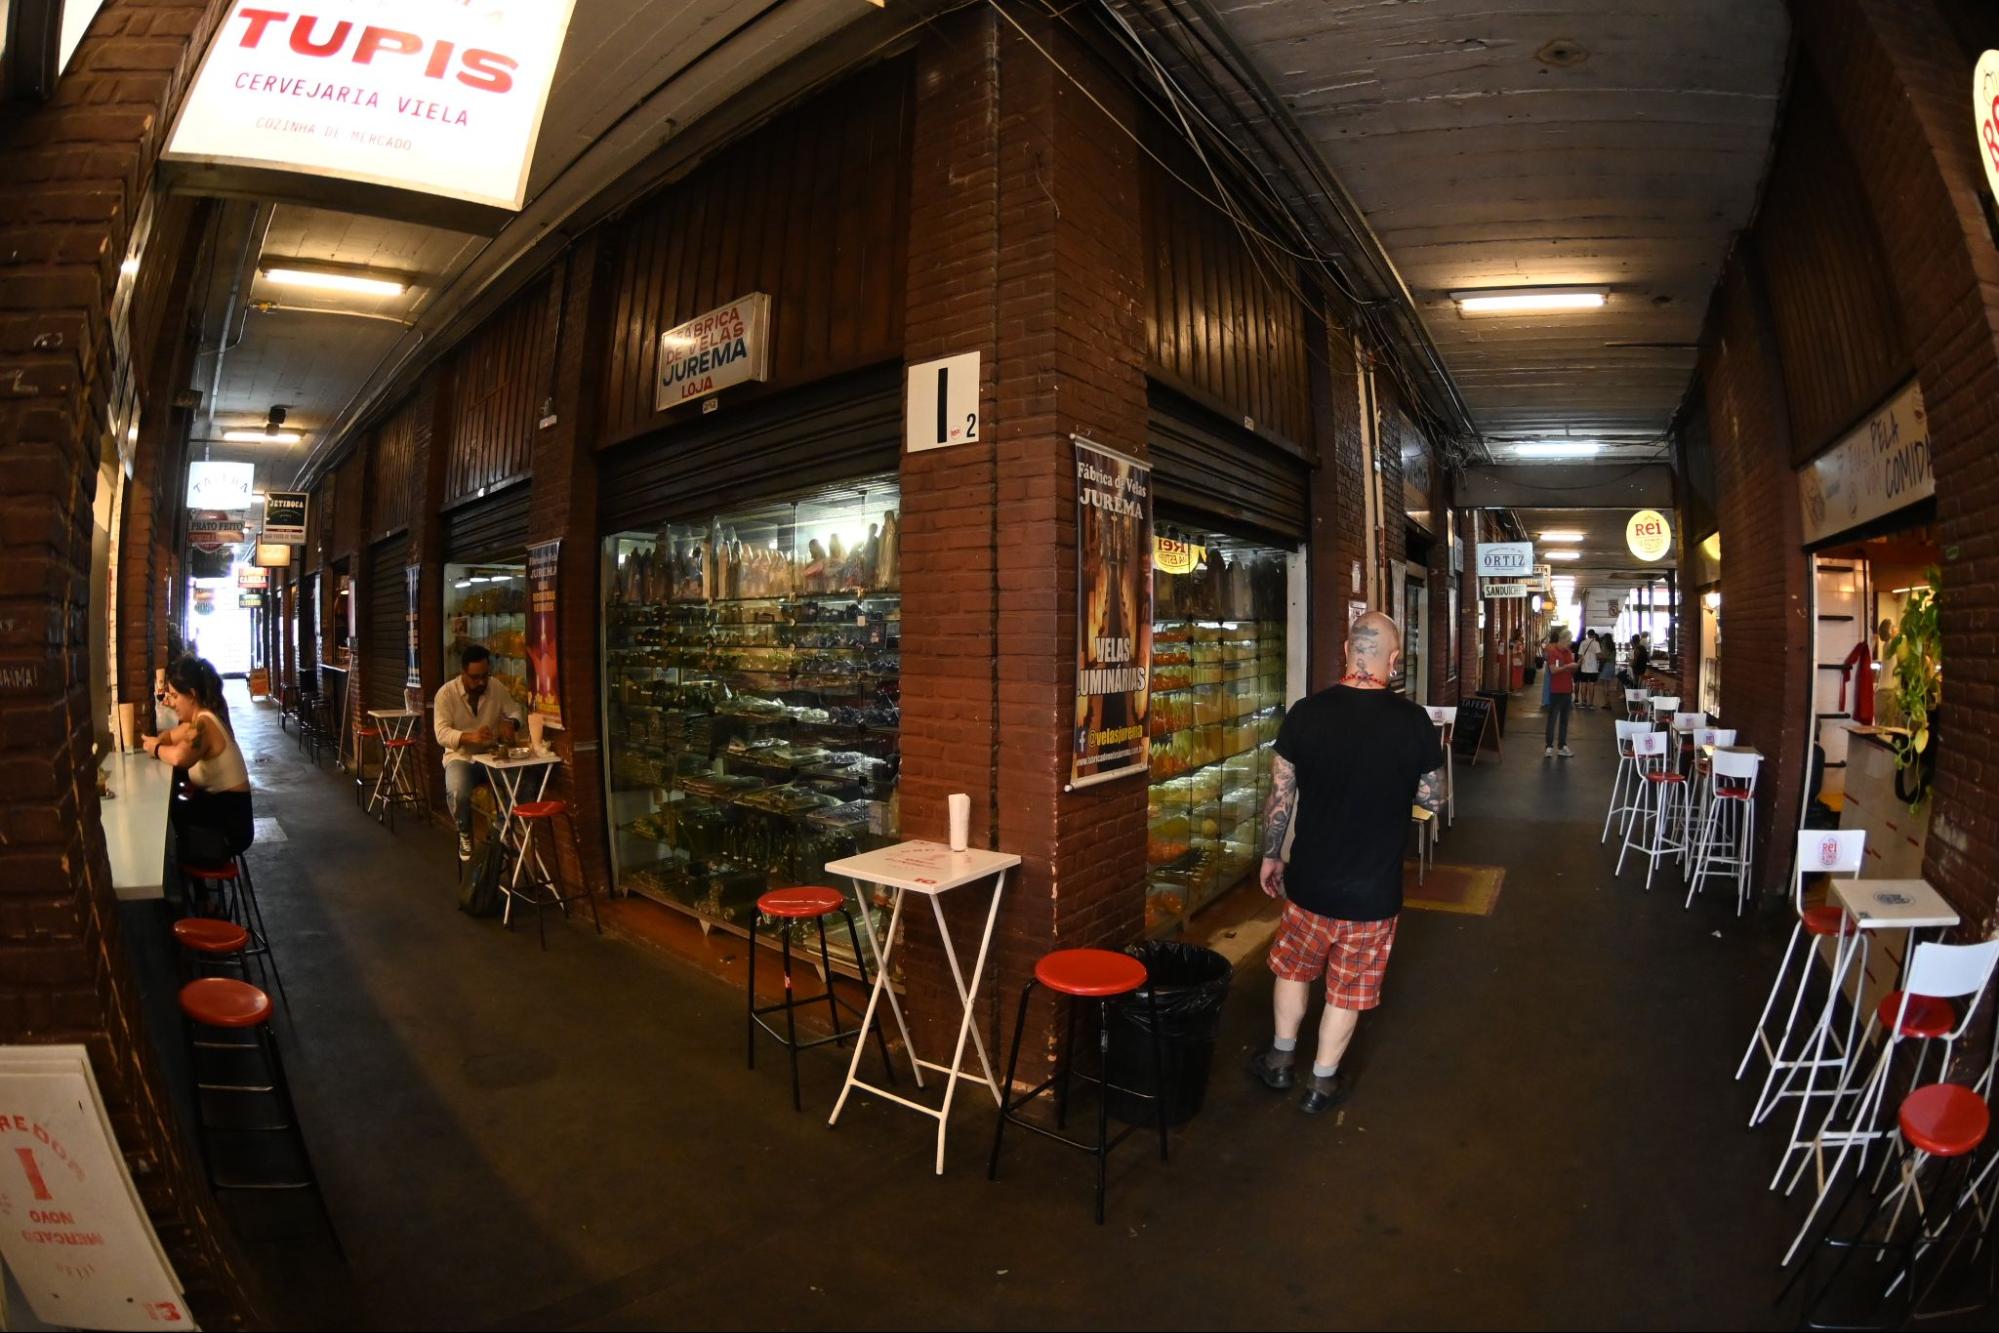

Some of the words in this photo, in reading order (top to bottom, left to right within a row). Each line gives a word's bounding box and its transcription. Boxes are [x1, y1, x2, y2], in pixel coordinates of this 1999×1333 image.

[237, 8, 519, 94] TUPIS
[234, 72, 380, 108] CERVEJARIA
[398, 97, 470, 127] VIELA
[255, 116, 315, 135] COZINHA
[324, 125, 341, 138] DE
[350, 130, 413, 151] MERCADO
[666, 347, 682, 365] DE
[690, 322, 745, 354] VELAS
[663, 337, 747, 386] JUREMA
[681, 376, 713, 399] LOJA
[965, 413, 977, 438] 2
[1870, 410, 1900, 457] PELA
[1077, 462, 1112, 485] Fábrica
[1126, 478, 1147, 498] Velas
[1079, 487, 1144, 520] JUREMA
[191, 522, 217, 531] PRATO
[219, 522, 243, 531] FEITO
[1635, 519, 1662, 536] Rei
[1484, 555, 1525, 567] ORTIZ
[1095, 637, 1131, 662] VELAS
[1077, 664, 1146, 697] UMINÁRIAS
[29, 1209, 75, 1226] NOVO
